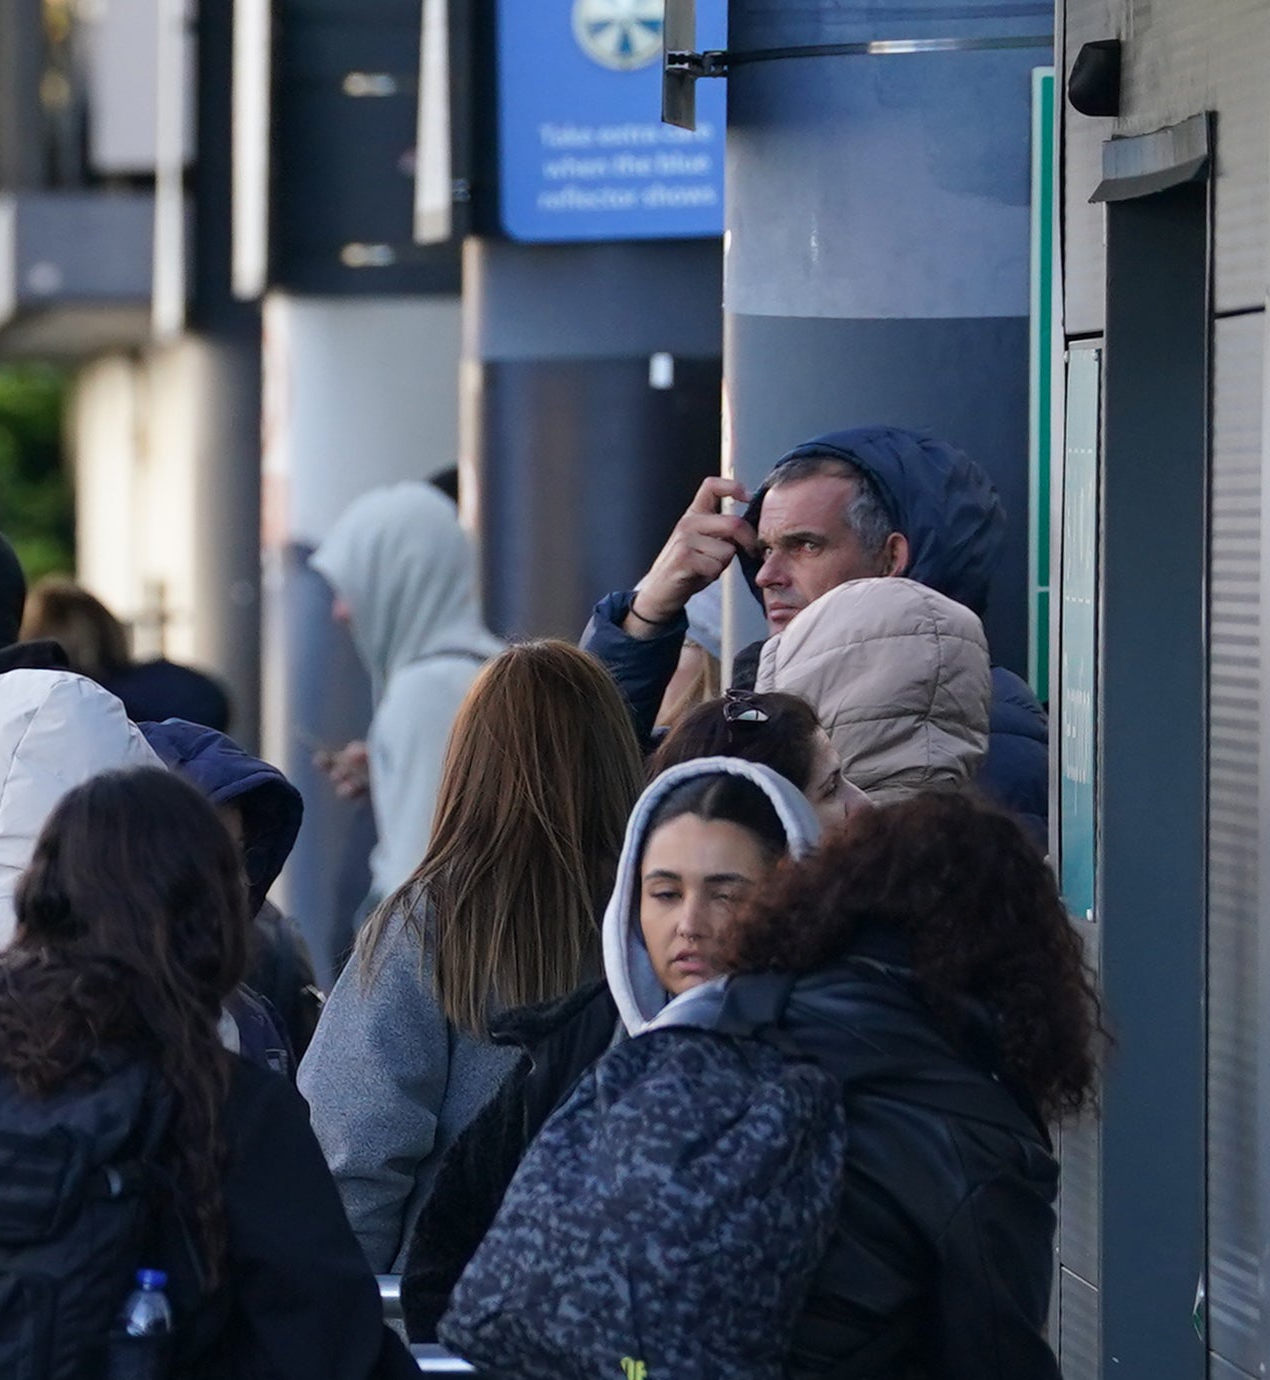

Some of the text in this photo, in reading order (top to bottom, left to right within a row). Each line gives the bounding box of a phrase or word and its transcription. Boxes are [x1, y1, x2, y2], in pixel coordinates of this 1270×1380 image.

[540, 124, 592, 145] Take
[595, 124, 658, 144] extra
[543, 152, 710, 178] when the blue
[538, 183, 716, 208] reflector shows
